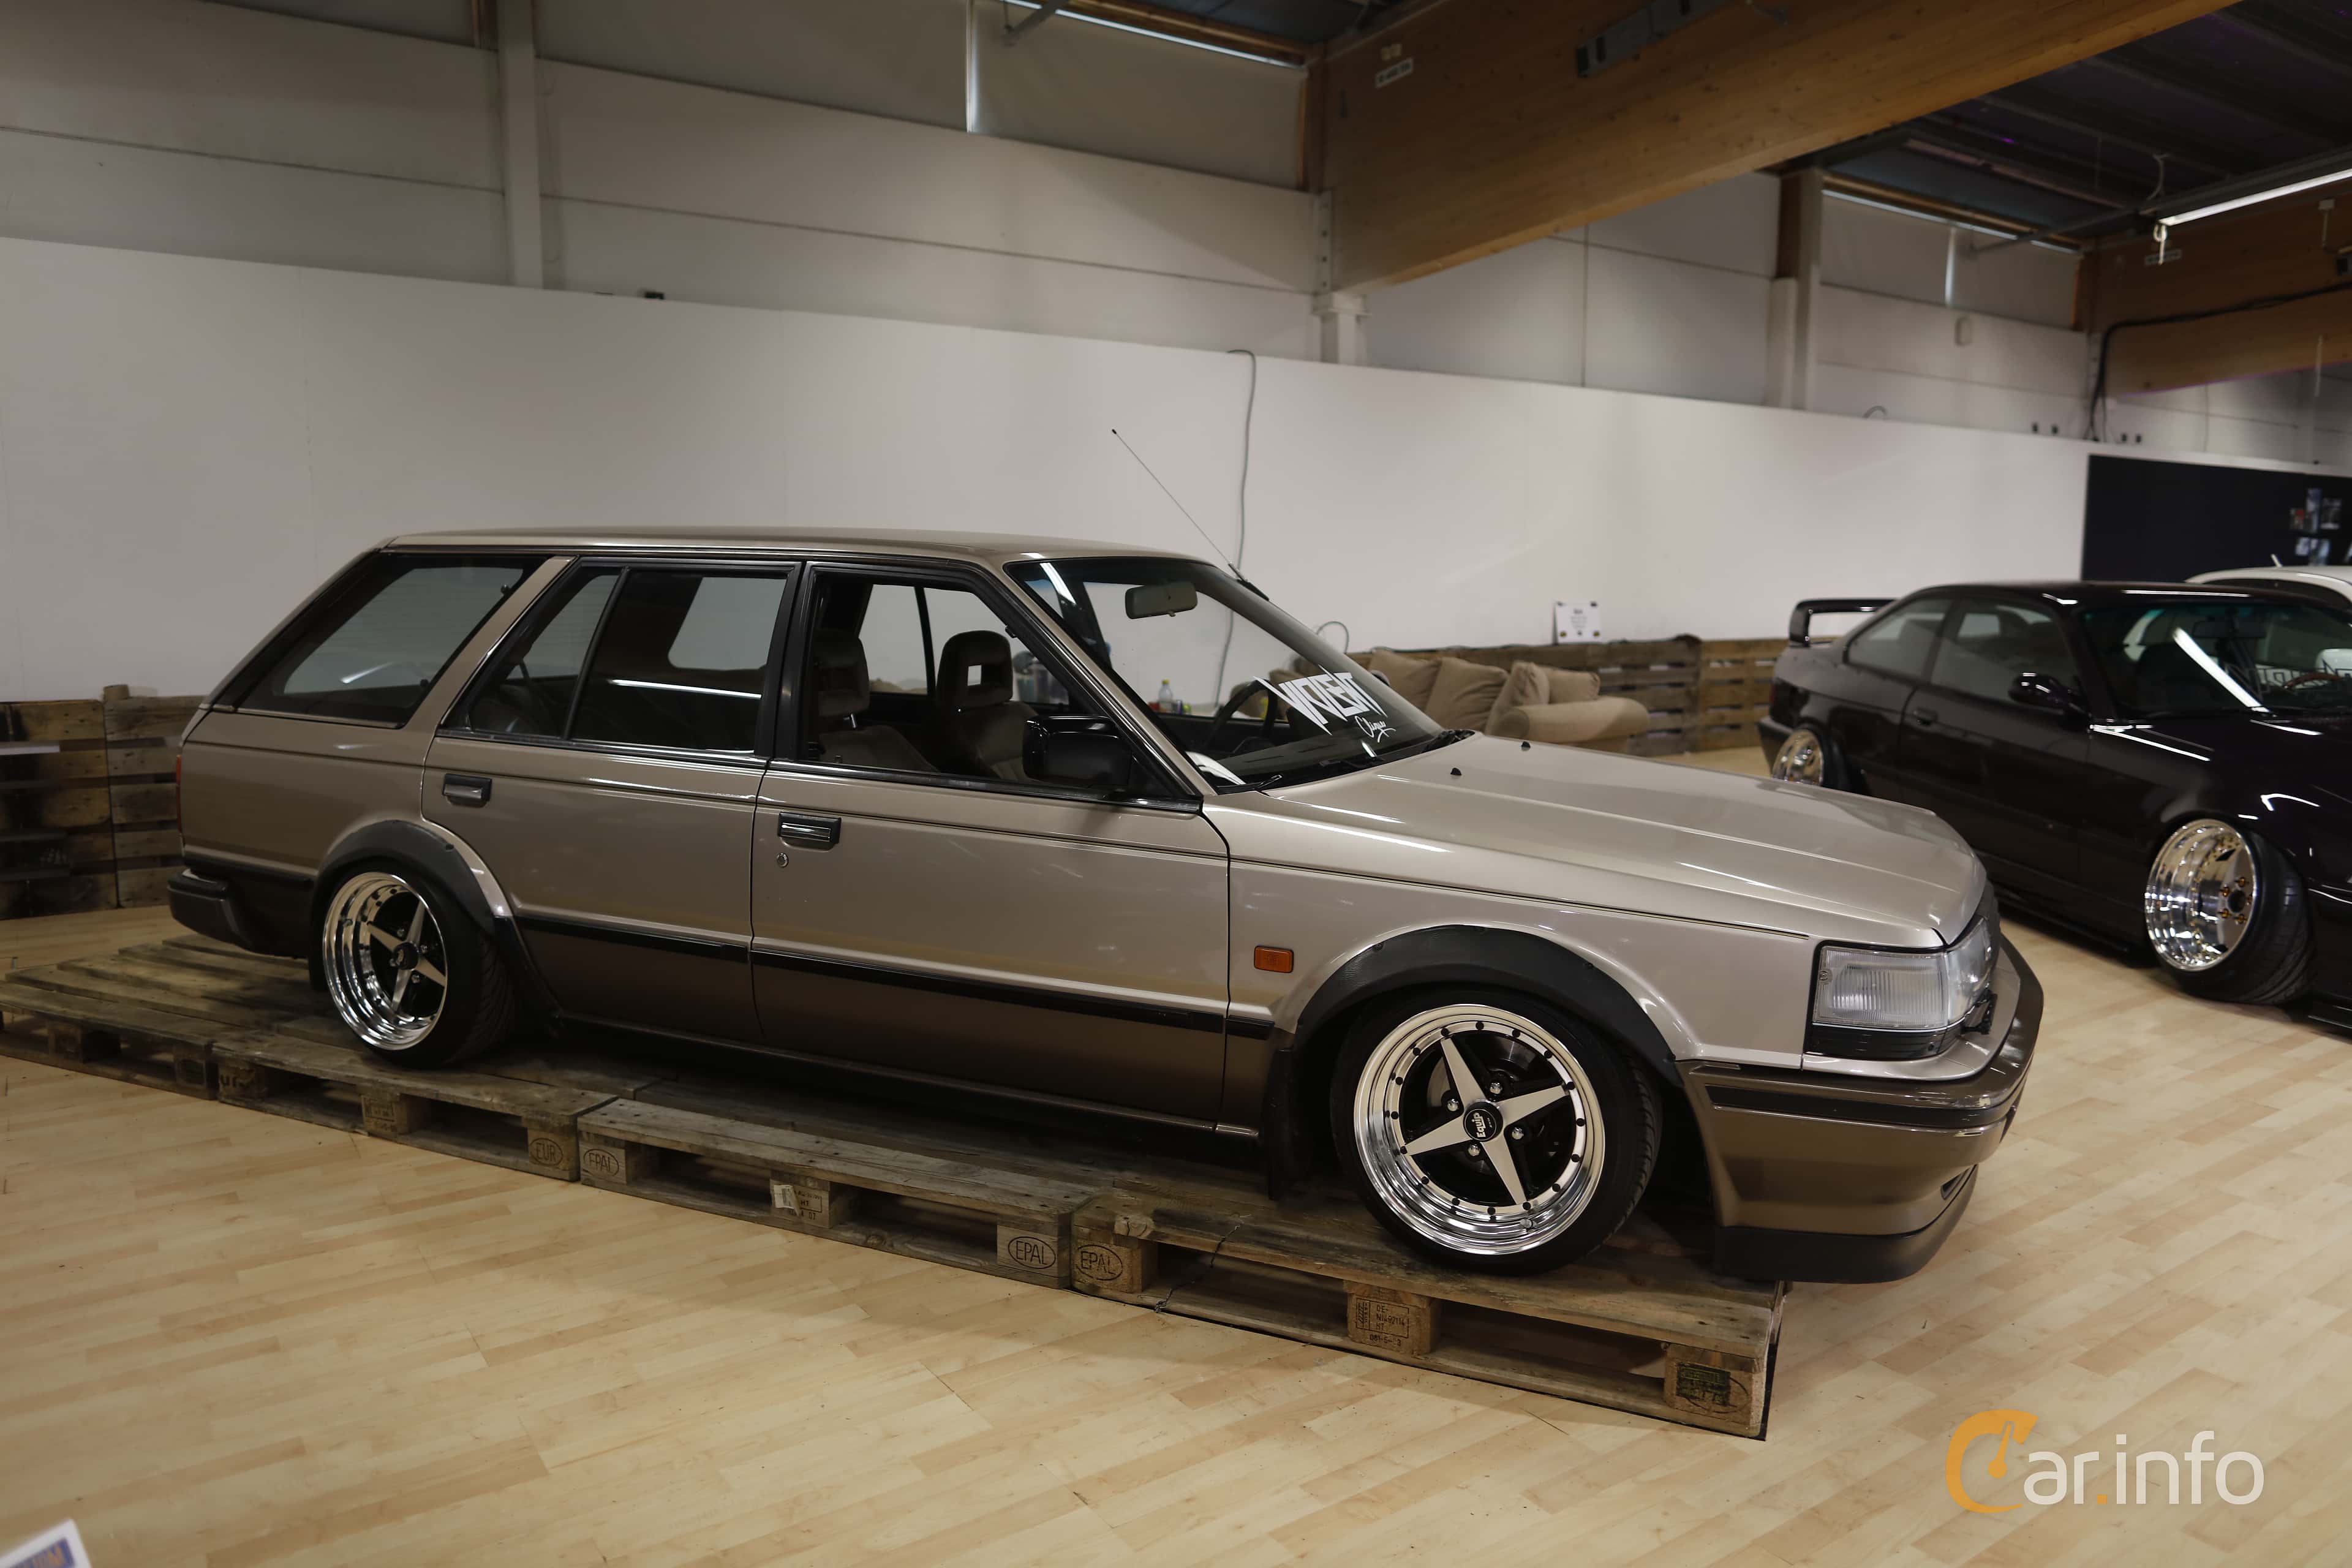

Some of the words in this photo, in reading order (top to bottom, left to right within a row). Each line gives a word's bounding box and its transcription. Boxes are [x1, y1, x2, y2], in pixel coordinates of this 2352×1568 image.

[1471, 1112, 1486, 1137] Equip
[536, 1142, 556, 1163] EUR
[1016, 1240, 1047, 1265] EPAL
[1080, 1251, 1116, 1276] EPAL
